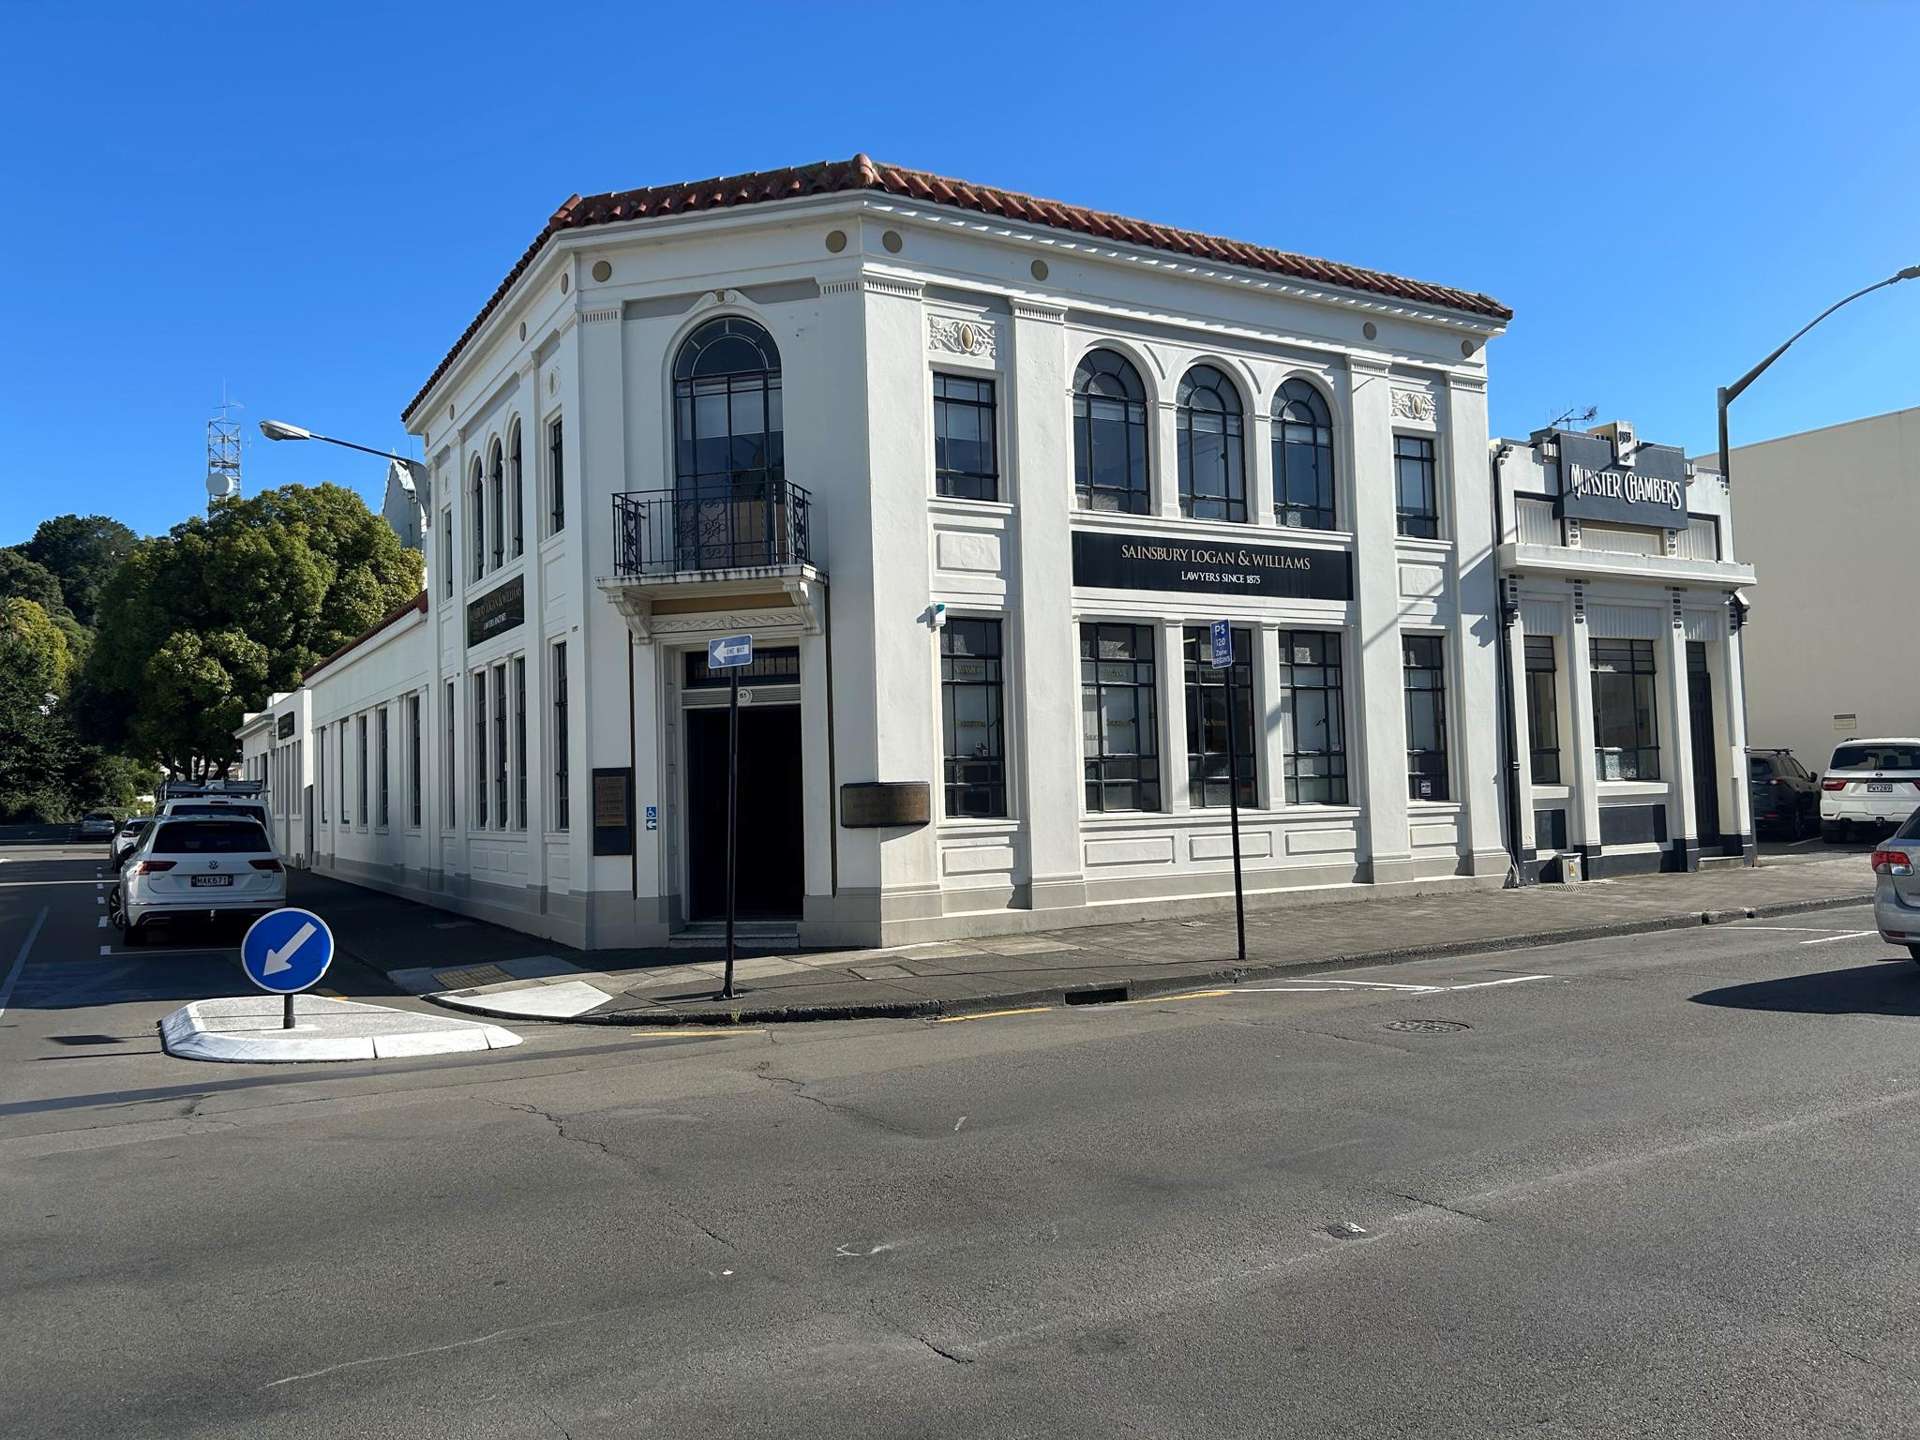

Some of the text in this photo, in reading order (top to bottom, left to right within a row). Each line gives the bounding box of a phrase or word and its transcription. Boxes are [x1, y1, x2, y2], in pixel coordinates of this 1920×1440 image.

[1570, 464, 1681, 510] MUNSTER CHAMBERS
[1121, 544, 1311, 570] SAINSBURY LOGAN & WILLIAMS
[1181, 571, 1261, 584] LAWYERS SINCE 1875
